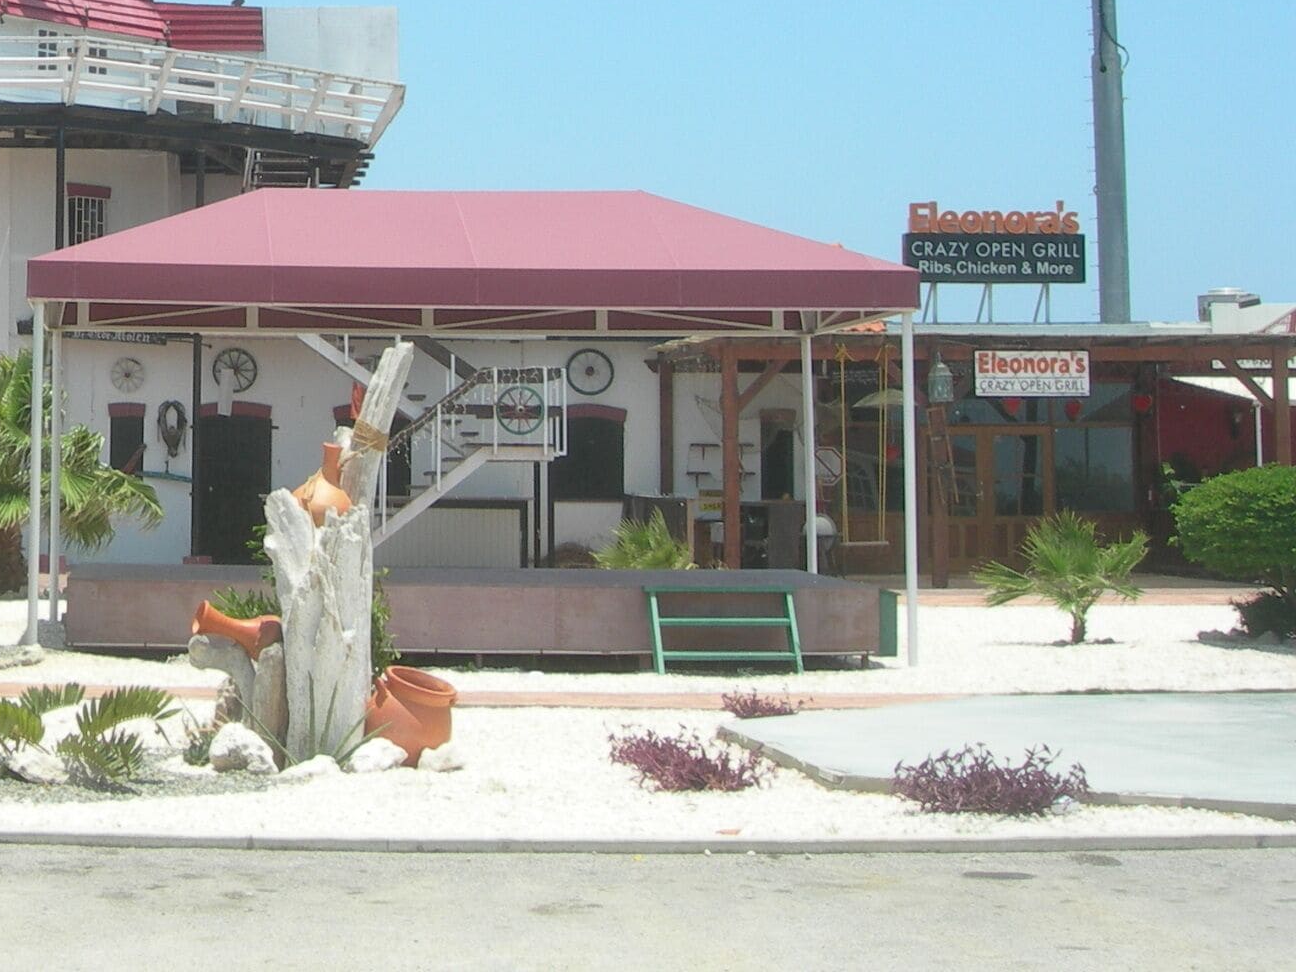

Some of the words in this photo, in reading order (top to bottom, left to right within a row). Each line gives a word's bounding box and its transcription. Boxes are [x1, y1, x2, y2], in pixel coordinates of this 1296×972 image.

[908, 200, 1080, 234] Eleonora's
[911, 241, 969, 257] CRAZY
[975, 242, 1025, 258] OPEN
[1032, 242, 1080, 258] GRILL
[1021, 261, 1032, 275] &
[1036, 261, 1074, 275] More
[978, 352, 1086, 374] Eleonora's
[980, 380, 1016, 390] CRAZY
